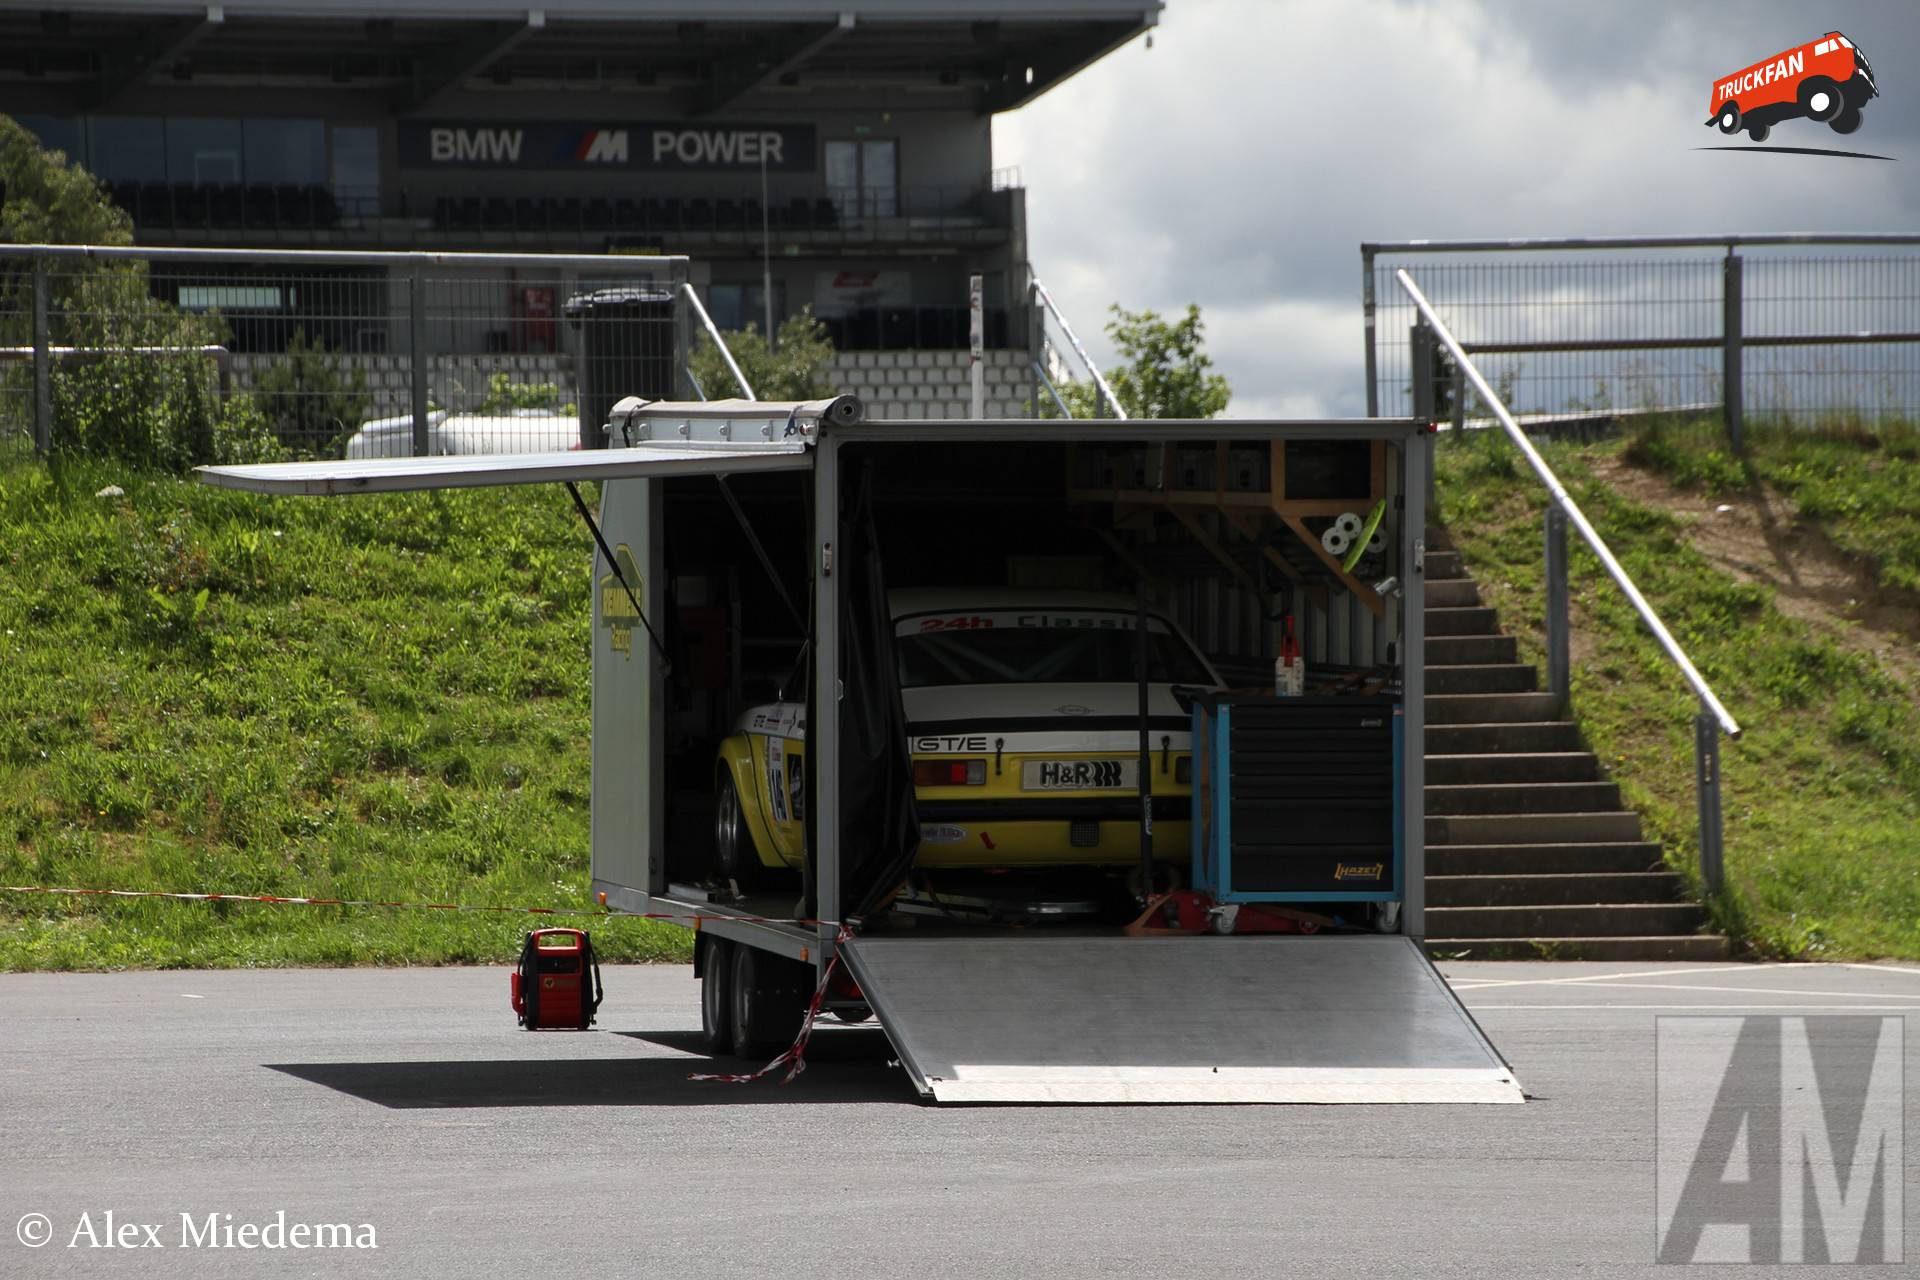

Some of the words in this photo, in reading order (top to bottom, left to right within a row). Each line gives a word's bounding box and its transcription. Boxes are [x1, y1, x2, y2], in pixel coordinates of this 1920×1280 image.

[430, 128, 523, 162] BMW
[652, 130, 784, 164] POWER
[919, 616, 994, 633] 24h
[917, 736, 987, 752] GT/E
[1039, 761, 1092, 788] H&R
